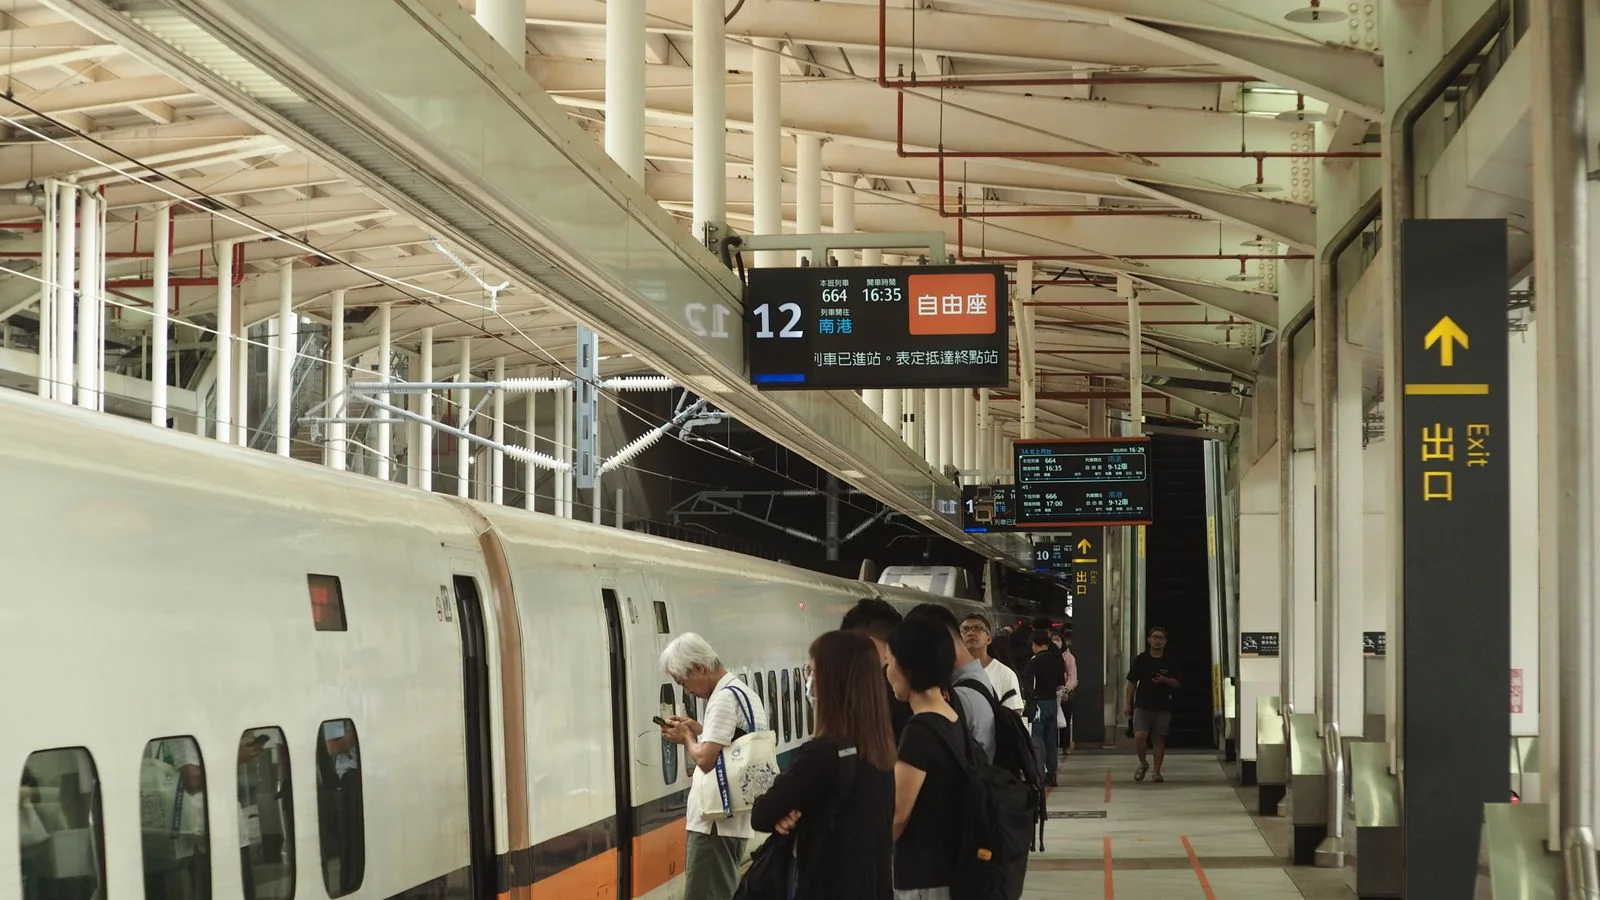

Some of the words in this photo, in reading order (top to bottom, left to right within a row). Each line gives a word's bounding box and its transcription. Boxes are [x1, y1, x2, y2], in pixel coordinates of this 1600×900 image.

[820, 279, 849, 287] 本班列車
[866, 278, 896, 286] 開車時間
[822, 288, 847, 302] 664
[862, 287, 902, 302] 16:35
[820, 308, 850, 316] 列車開往
[917, 293, 988, 316] 自由座
[752, 302, 804, 338] 12
[819, 318, 853, 334] 南港
[1466, 423, 1490, 467] Exit
[1421, 423, 1455, 501] 出口
[1036, 551, 1049, 560] 10
[1076, 570, 1087, 595] 出口
